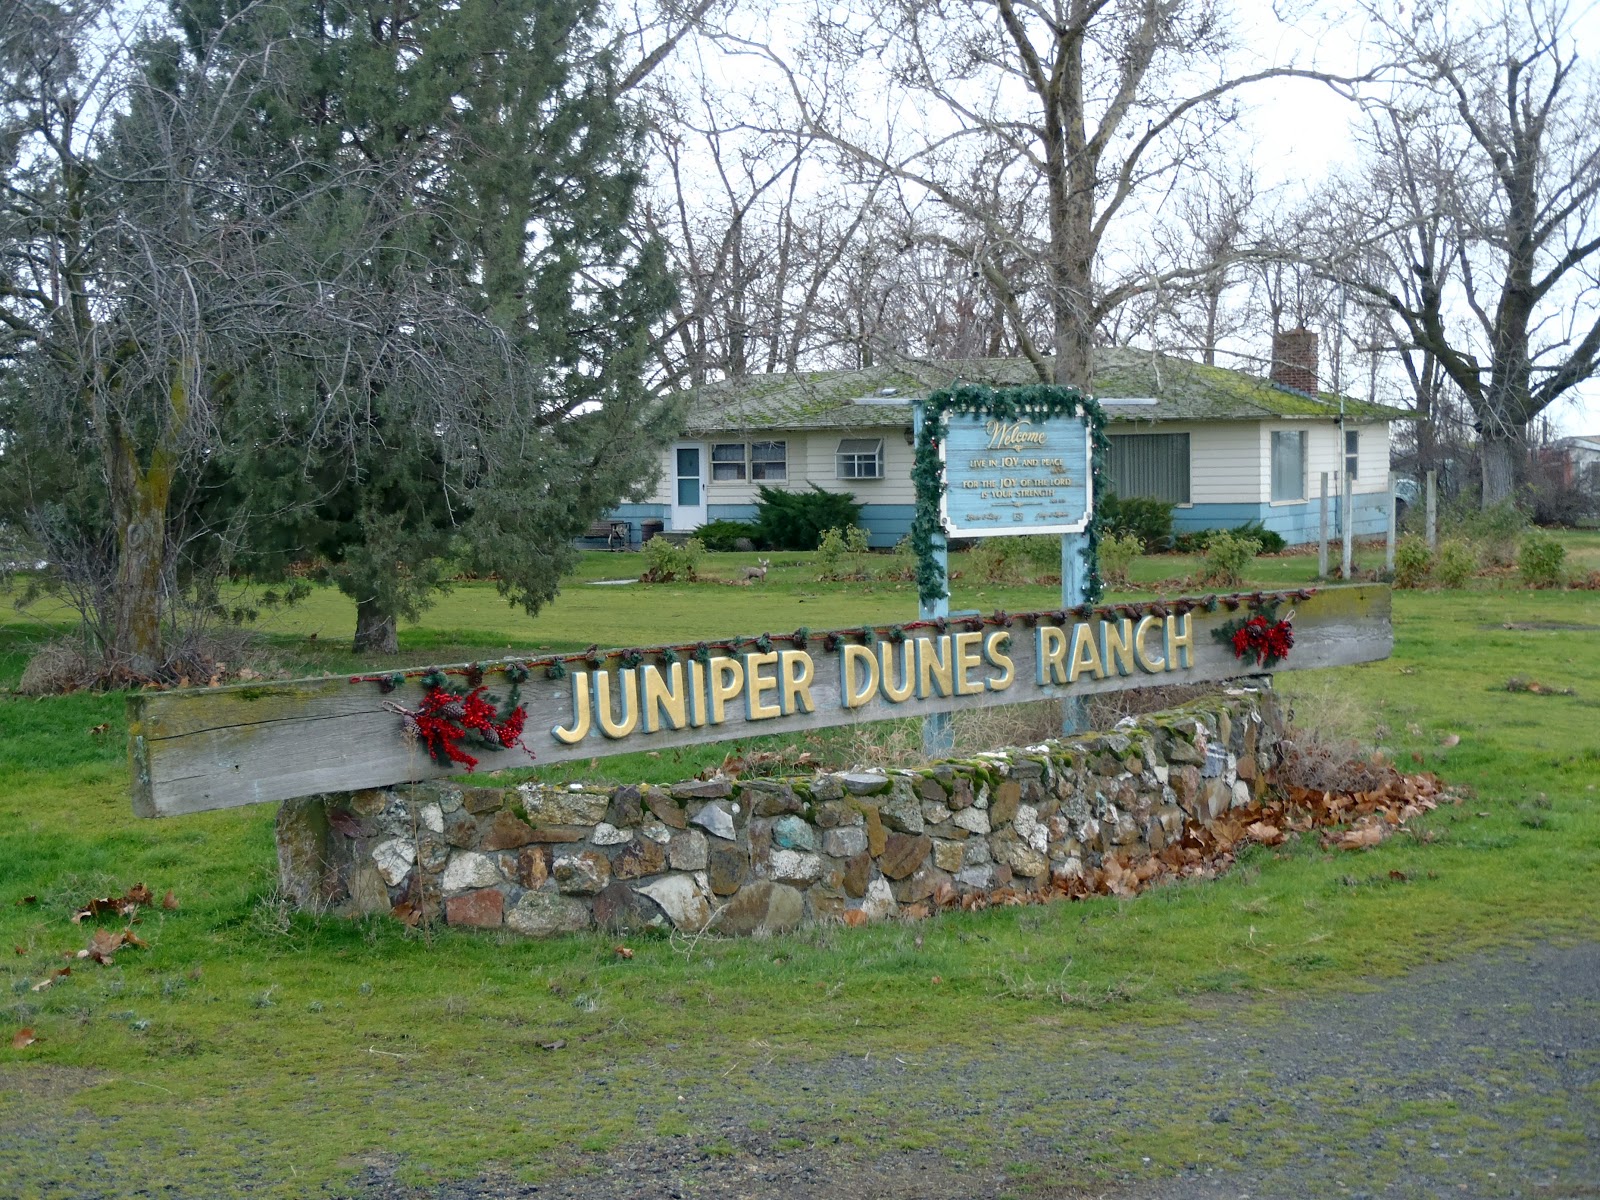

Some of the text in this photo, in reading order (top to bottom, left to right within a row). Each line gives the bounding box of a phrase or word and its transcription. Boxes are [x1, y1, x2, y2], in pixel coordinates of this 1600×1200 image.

[986, 420, 1046, 449] Welcome
[970, 460, 986, 468] LIVE
[988, 459, 998, 467] IN
[1001, 457, 1019, 467] JOY
[1041, 458, 1064, 466] PEACE
[963, 480, 979, 488] FOR
[981, 480, 996, 488] THE
[999, 478, 1018, 488] JOY
[1020, 479, 1031, 487] OF
[1050, 478, 1072, 486] LORD
[981, 489, 1055, 499] IS YOUR STRENGTH
[551, 612, 1194, 745] JUNIPER DUNES RANCH
